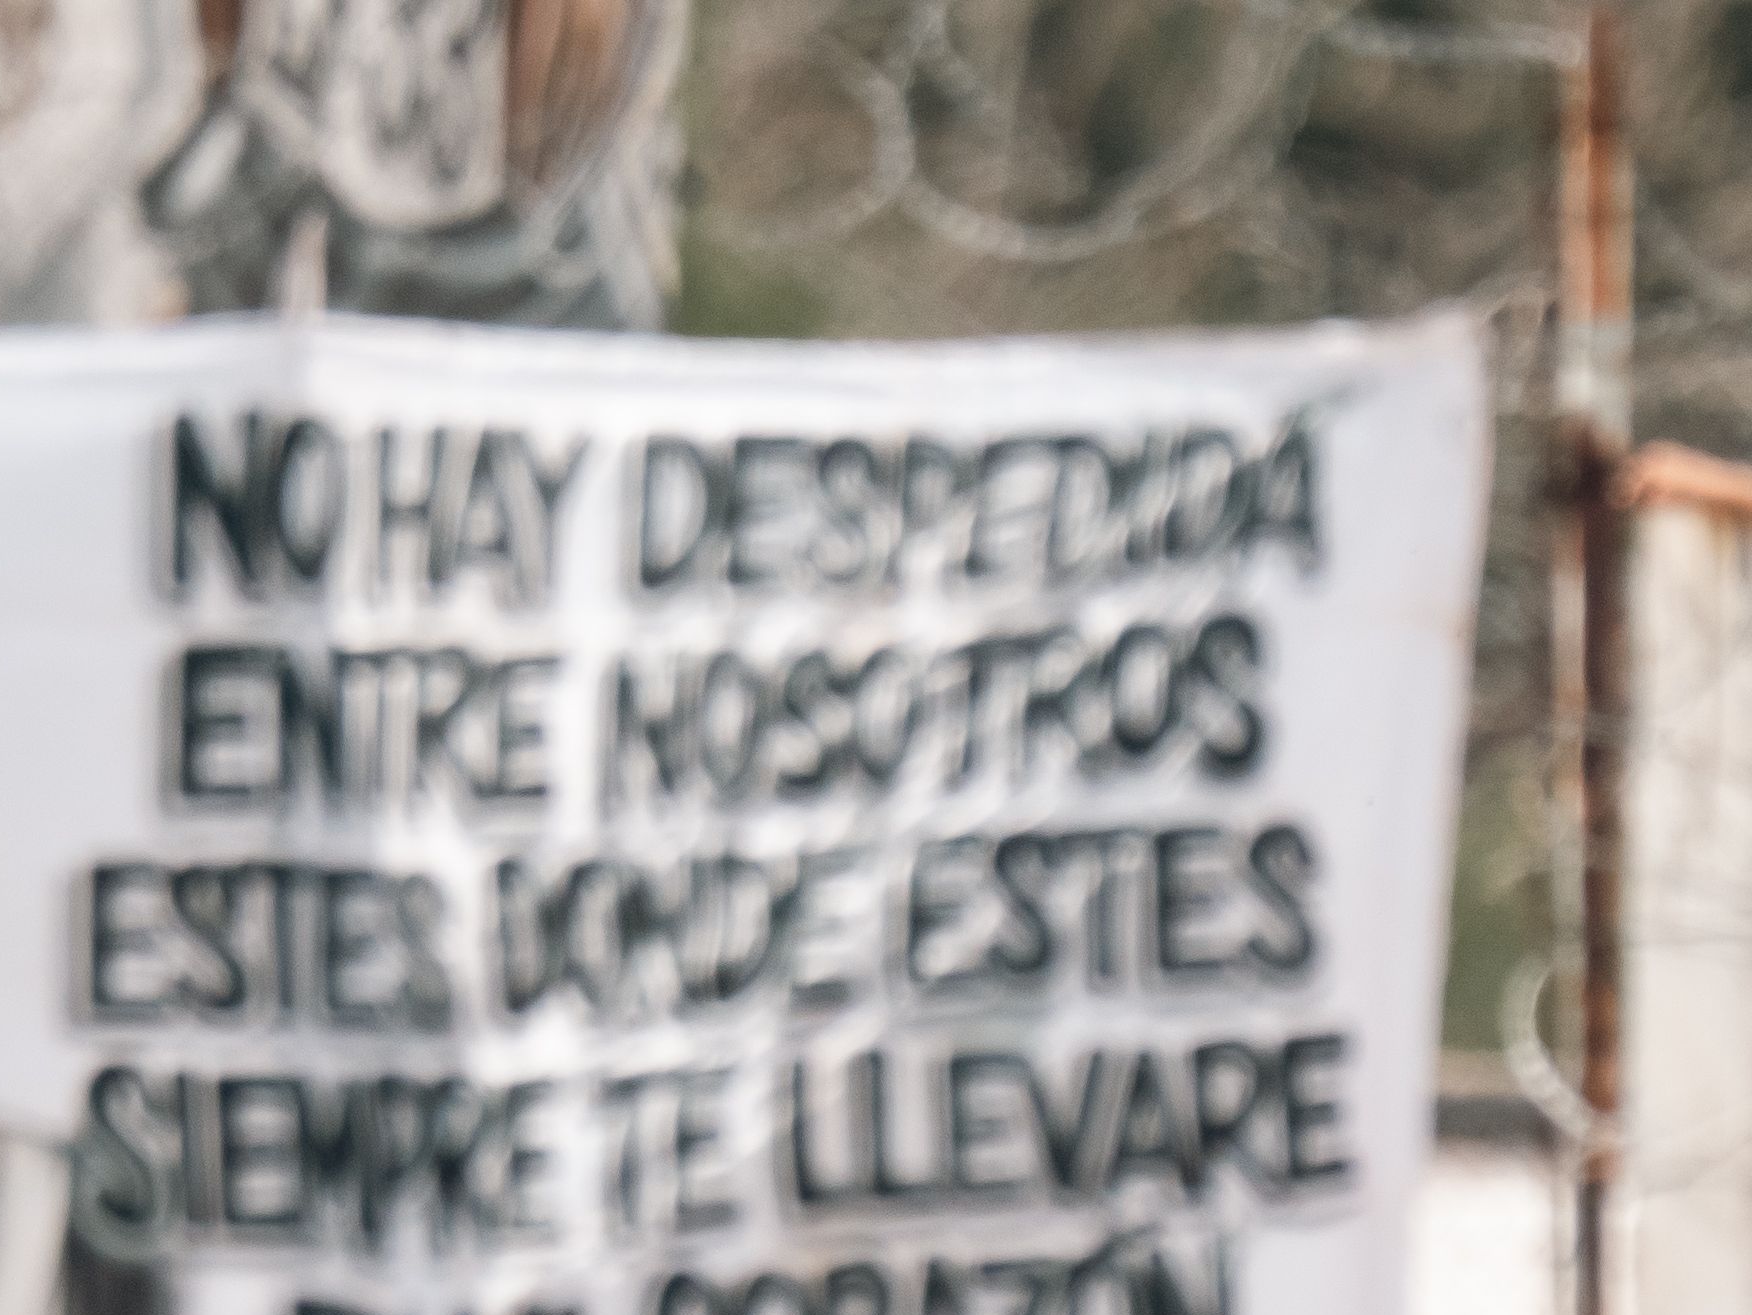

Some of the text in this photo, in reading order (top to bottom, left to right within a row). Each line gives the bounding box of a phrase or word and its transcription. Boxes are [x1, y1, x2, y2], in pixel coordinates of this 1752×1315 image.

[170, 410, 1324, 592] NO HAY DESPEDIDA
[178, 612, 1268, 800] ENTRE NOSOTROS
[86, 822, 1318, 1012] ESTES DONDE ESTES
[83, 1030, 1354, 1240] SIEMPRE TE LLEVARE
